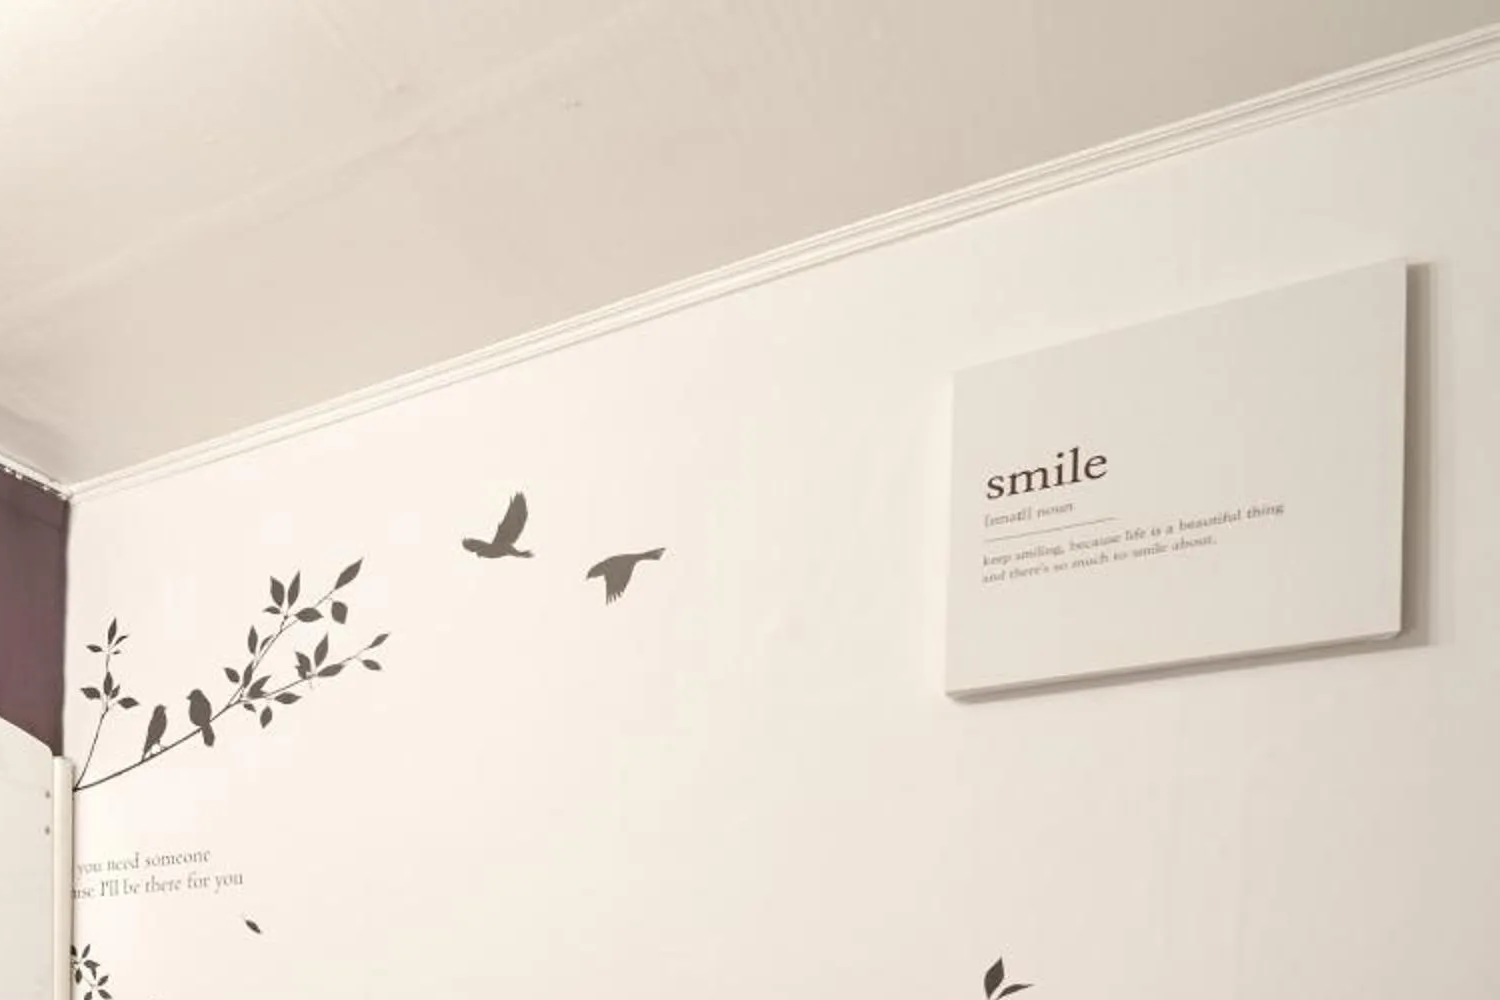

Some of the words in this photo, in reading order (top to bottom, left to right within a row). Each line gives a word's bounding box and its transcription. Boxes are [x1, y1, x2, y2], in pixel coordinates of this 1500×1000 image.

[986, 446, 1108, 500] smile
[1069, 535, 1122, 551] because
[1125, 527, 1146, 541] life
[1151, 525, 1162, 537] is
[1165, 523, 1174, 534] a
[1179, 508, 1241, 531] beautiful
[1247, 503, 1285, 519] thing
[1072, 552, 1108, 568] much
[107, 851, 139, 871] need
[144, 850, 211, 867] someone
[101, 879, 119, 897] I'll
[123, 878, 141, 895] be
[145, 874, 182, 893] there
[187, 870, 211, 888] for
[213, 873, 244, 894] you
